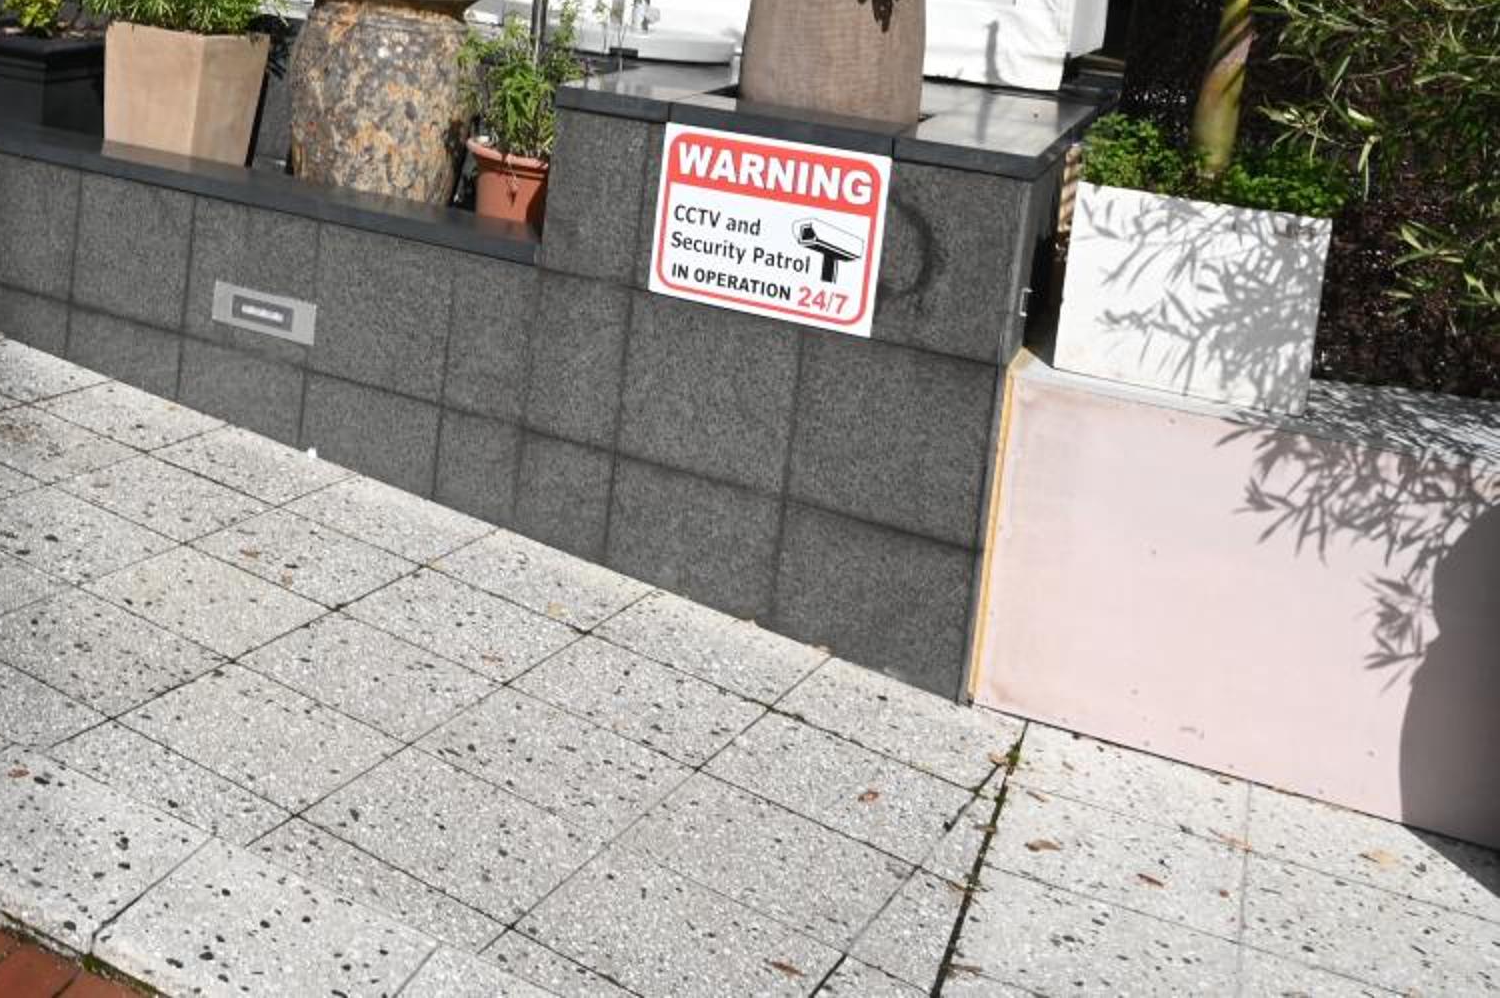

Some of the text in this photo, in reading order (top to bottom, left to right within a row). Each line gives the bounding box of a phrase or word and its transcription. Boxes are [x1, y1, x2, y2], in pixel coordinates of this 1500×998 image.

[678, 142, 872, 205] WARNING
[673, 204, 762, 236] CCTV and
[670, 231, 811, 274] Security Patrol
[671, 263, 850, 314] IN OPERATION 24/7
